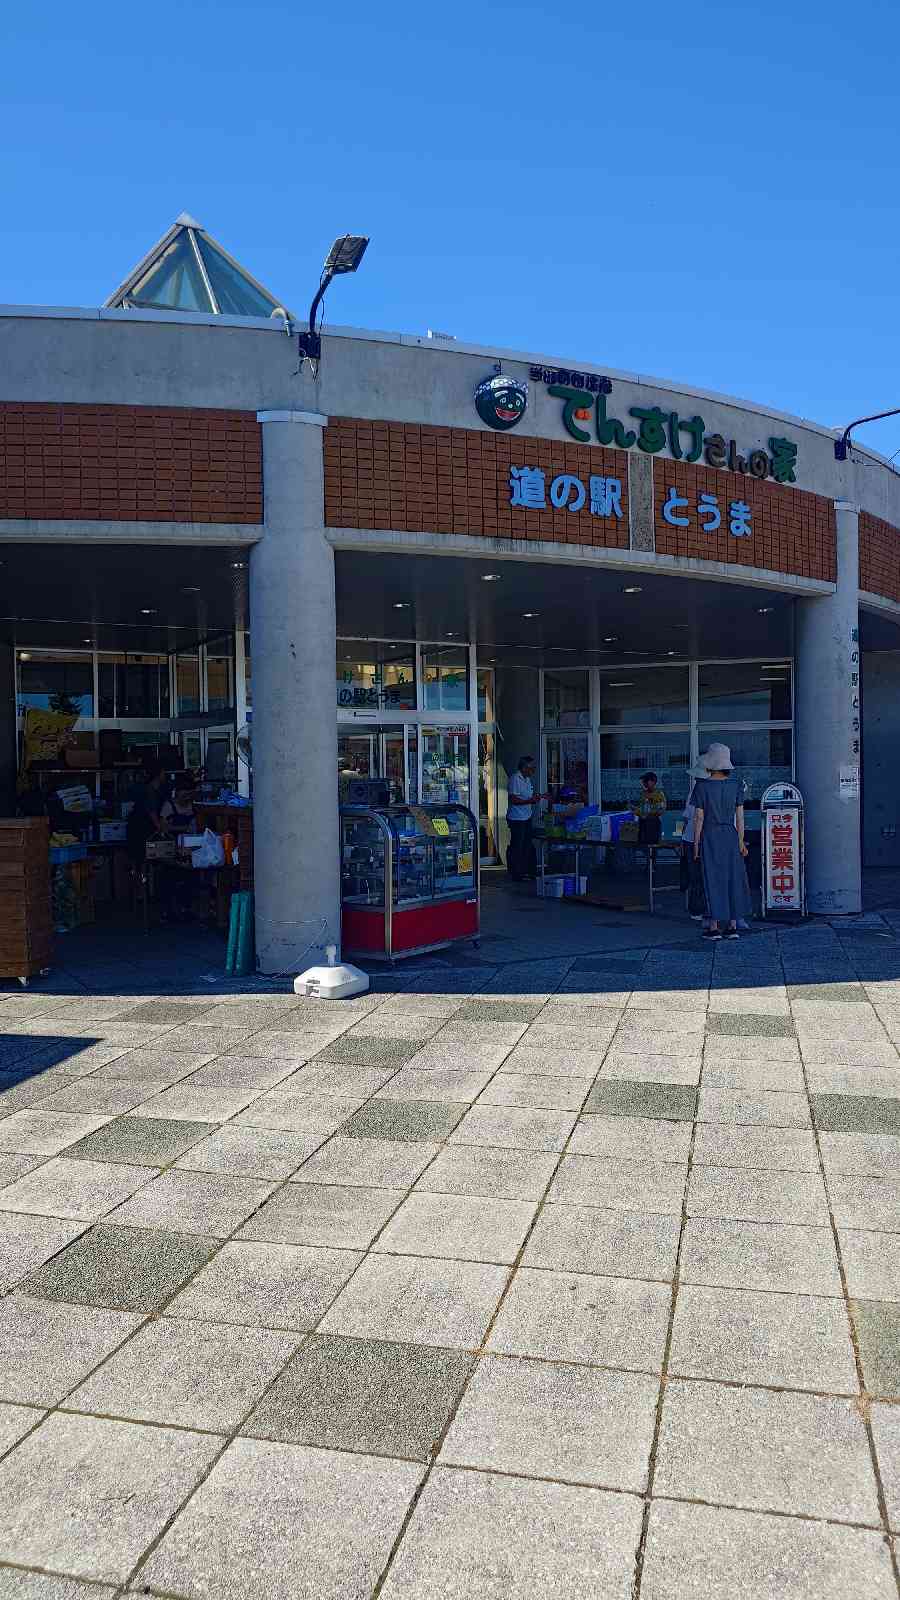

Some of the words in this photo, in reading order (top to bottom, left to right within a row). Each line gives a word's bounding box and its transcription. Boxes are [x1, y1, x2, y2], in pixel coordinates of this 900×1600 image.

[547, 385, 797, 483] でんすけさんの家
[508, 465, 624, 520] 道の駅
[663, 487, 753, 537] とうま
[770, 824, 794, 889] 営業中
